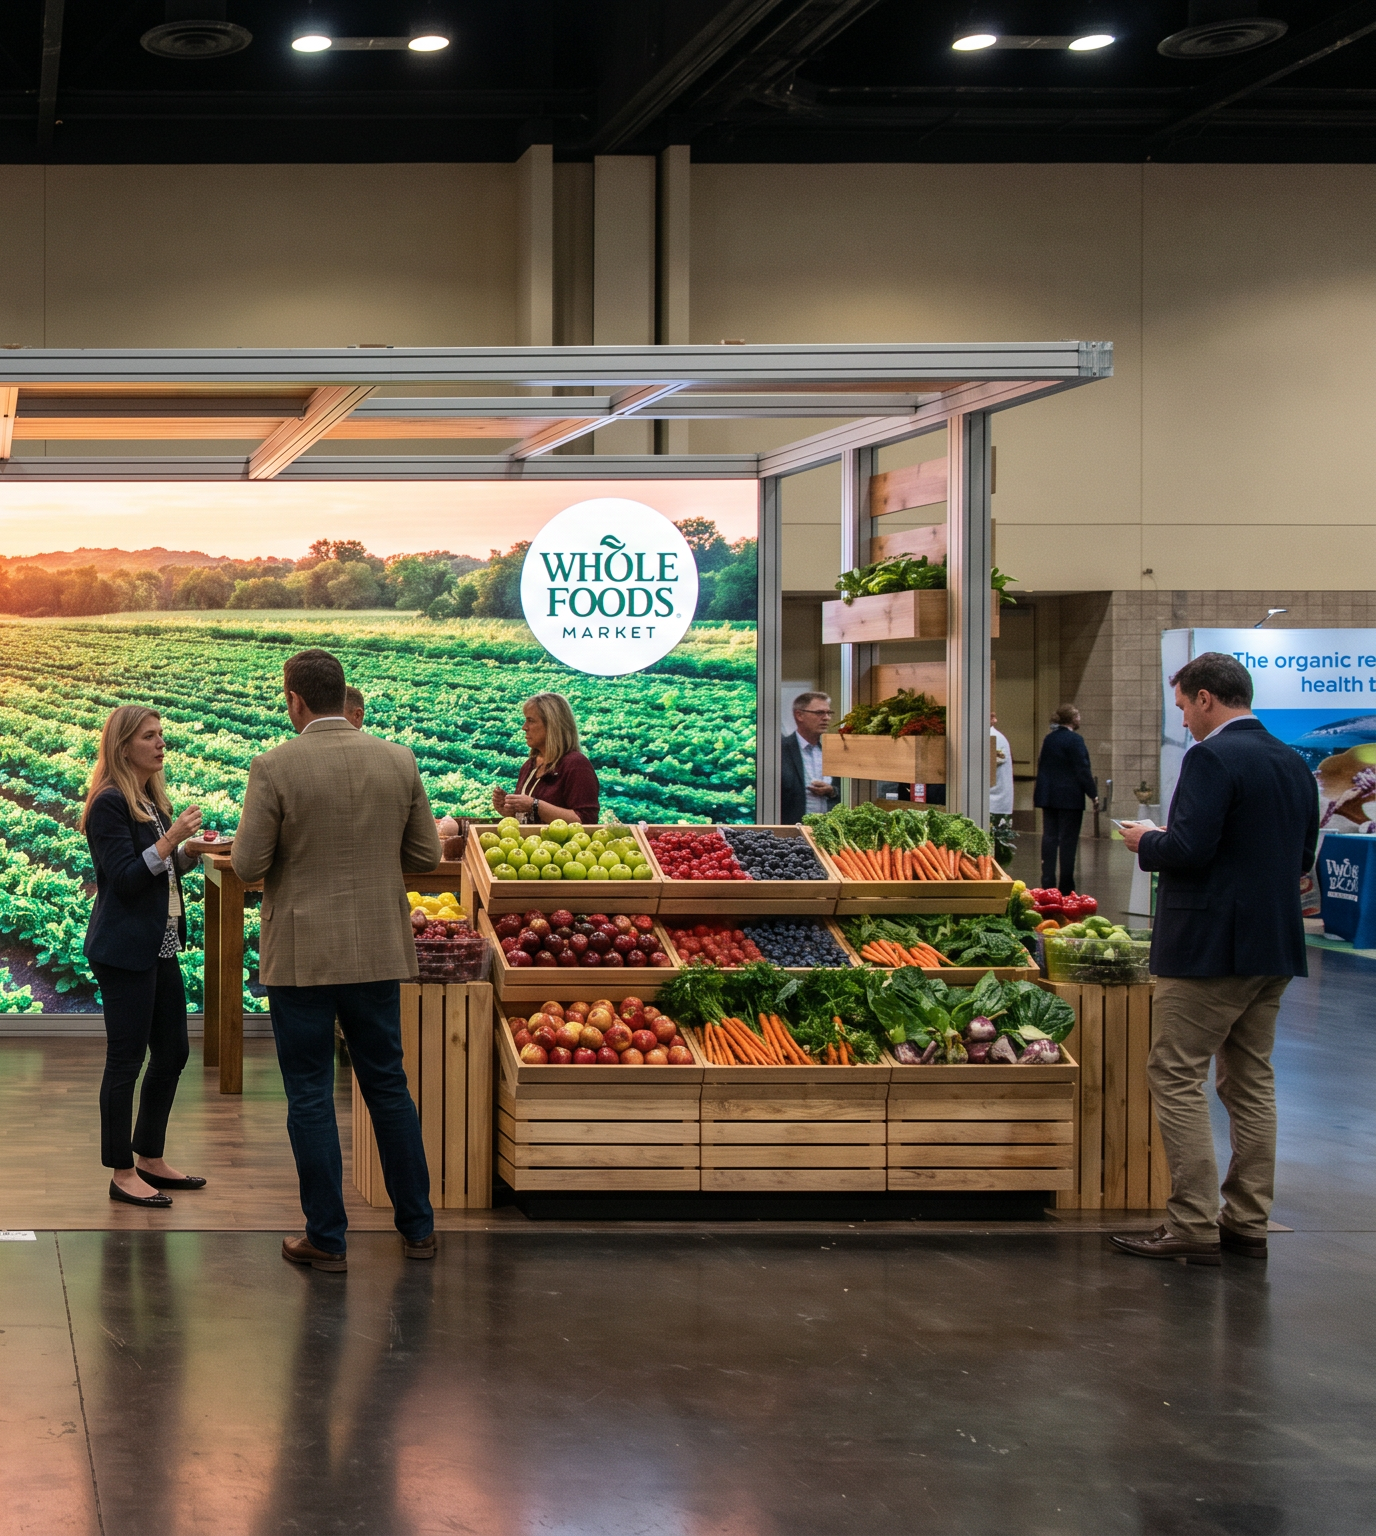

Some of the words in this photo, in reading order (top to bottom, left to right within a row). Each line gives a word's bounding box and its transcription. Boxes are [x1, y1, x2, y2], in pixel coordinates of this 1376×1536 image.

[539, 552, 679, 582] WHOLE
[546, 587, 674, 618] FOODS
[562, 626, 656, 639] MARKET
[1232, 652, 1269, 668] The
[1274, 651, 1352, 672] organic
[1301, 676, 1364, 692] health
